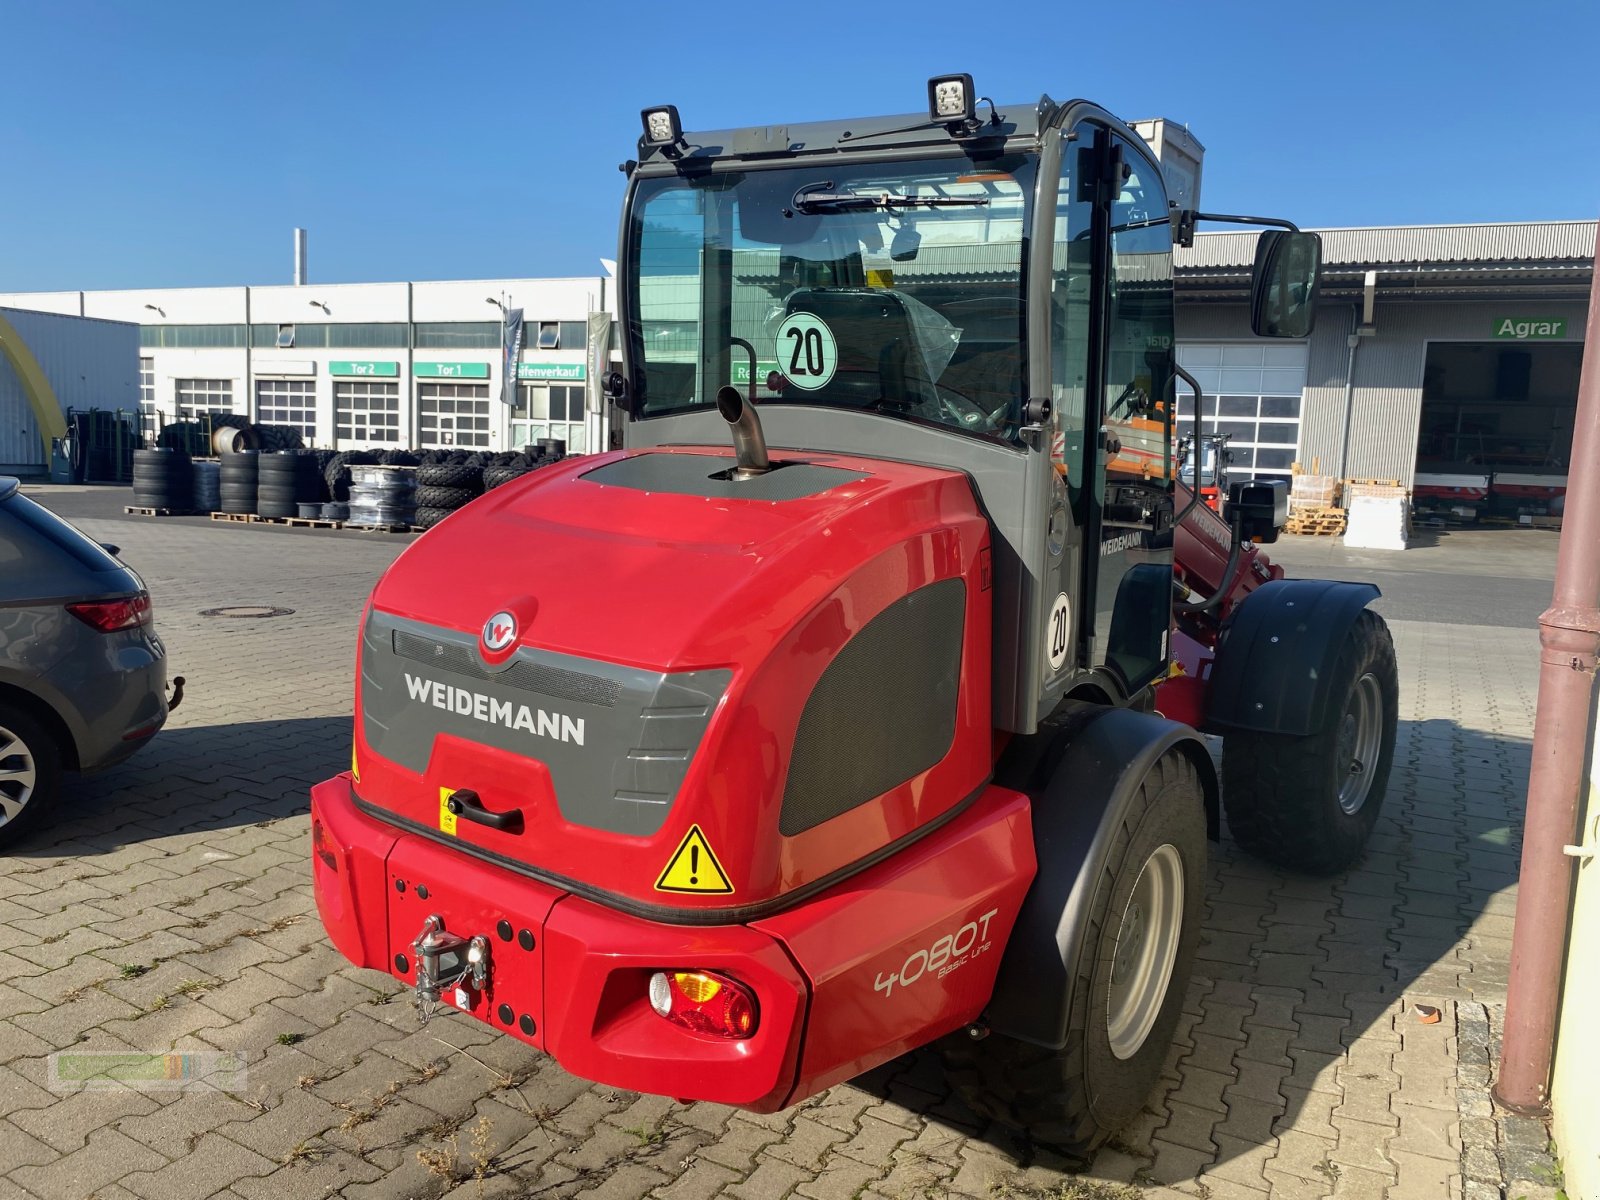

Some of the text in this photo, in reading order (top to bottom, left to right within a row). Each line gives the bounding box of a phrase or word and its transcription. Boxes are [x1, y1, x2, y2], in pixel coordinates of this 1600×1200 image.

[1498, 319, 1562, 338] Agrar
[786, 327, 824, 376] 20
[350, 364, 375, 375] Tor 2
[437, 365, 461, 376] Tor 1
[518, 365, 580, 378] ifenverkauf
[1100, 530, 1142, 557] WEIDEMANN
[1052, 606, 1066, 658] 20
[405, 673, 585, 746] WEIDEMANN
[874, 908, 998, 997] 4080T
[938, 941, 991, 979] Basic Line
